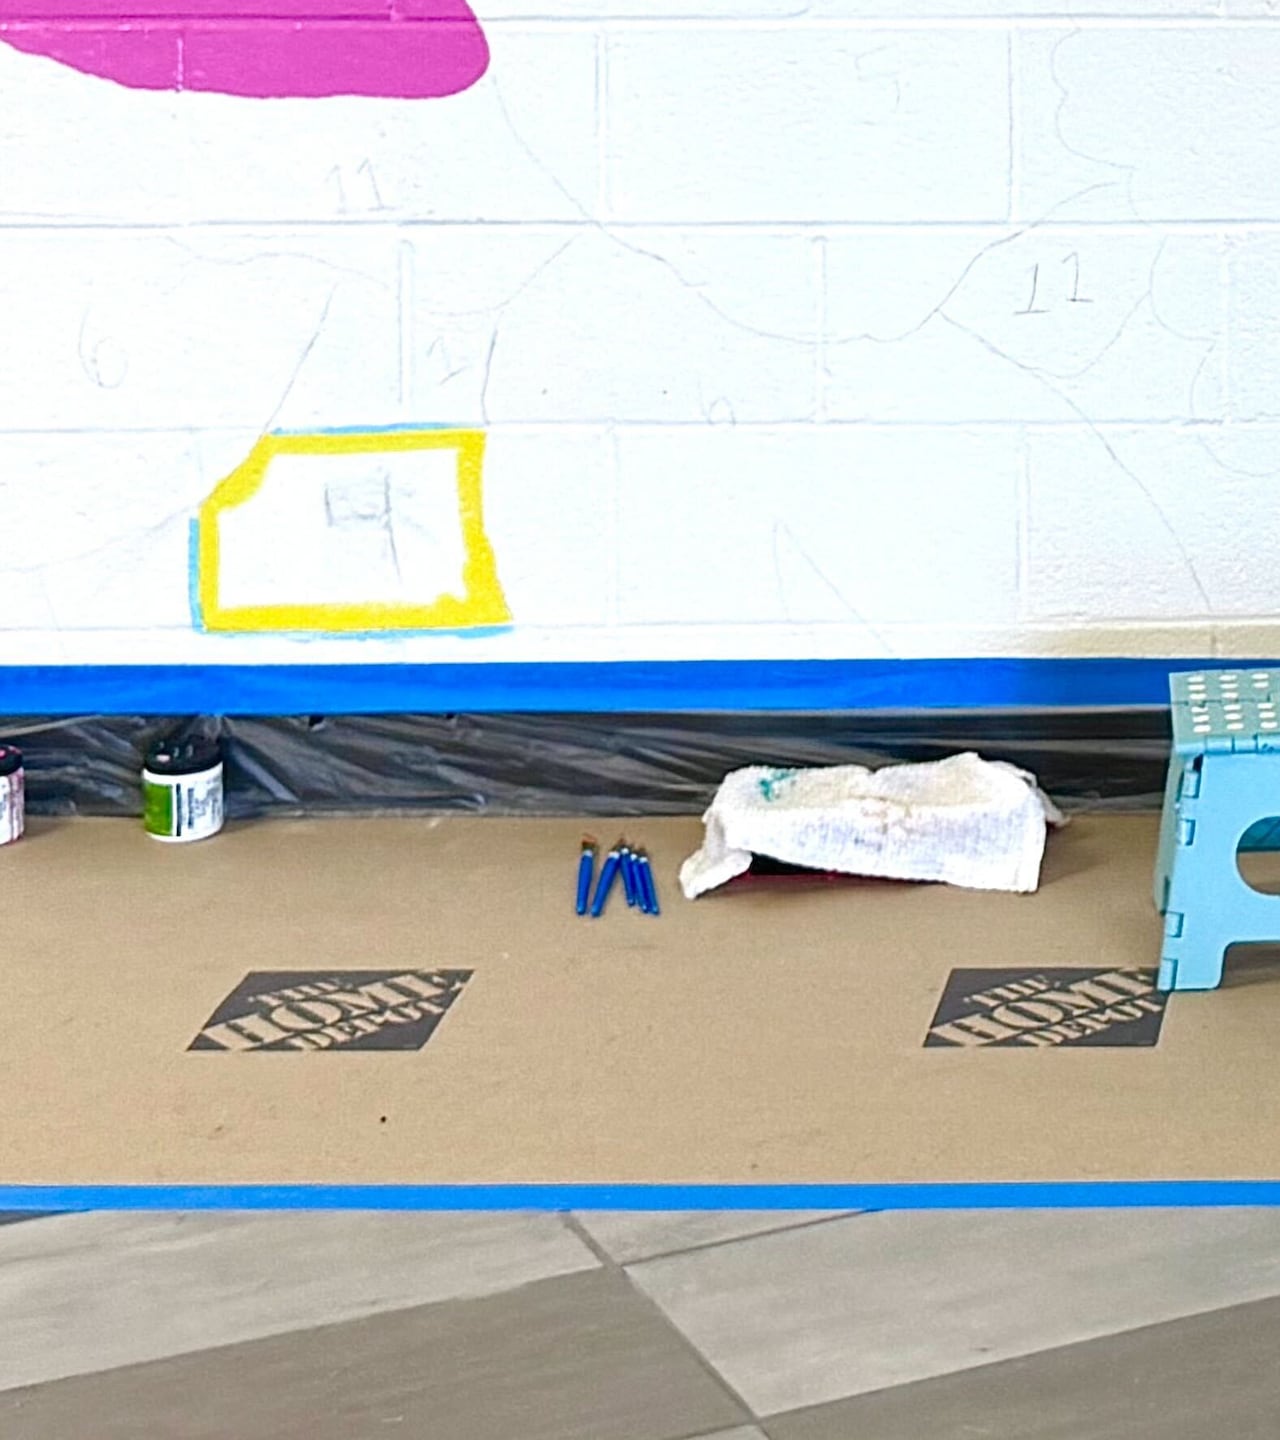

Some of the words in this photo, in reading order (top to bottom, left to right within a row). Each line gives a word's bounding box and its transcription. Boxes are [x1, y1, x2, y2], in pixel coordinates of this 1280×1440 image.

[1013, 250, 1095, 316] 11
[201, 970, 465, 1050] HOME
[249, 978, 354, 1007] THE
[963, 974, 1061, 1007] THE
[284, 999, 446, 1050] DEPOT
[1017, 998, 1164, 1046] DEPOT
